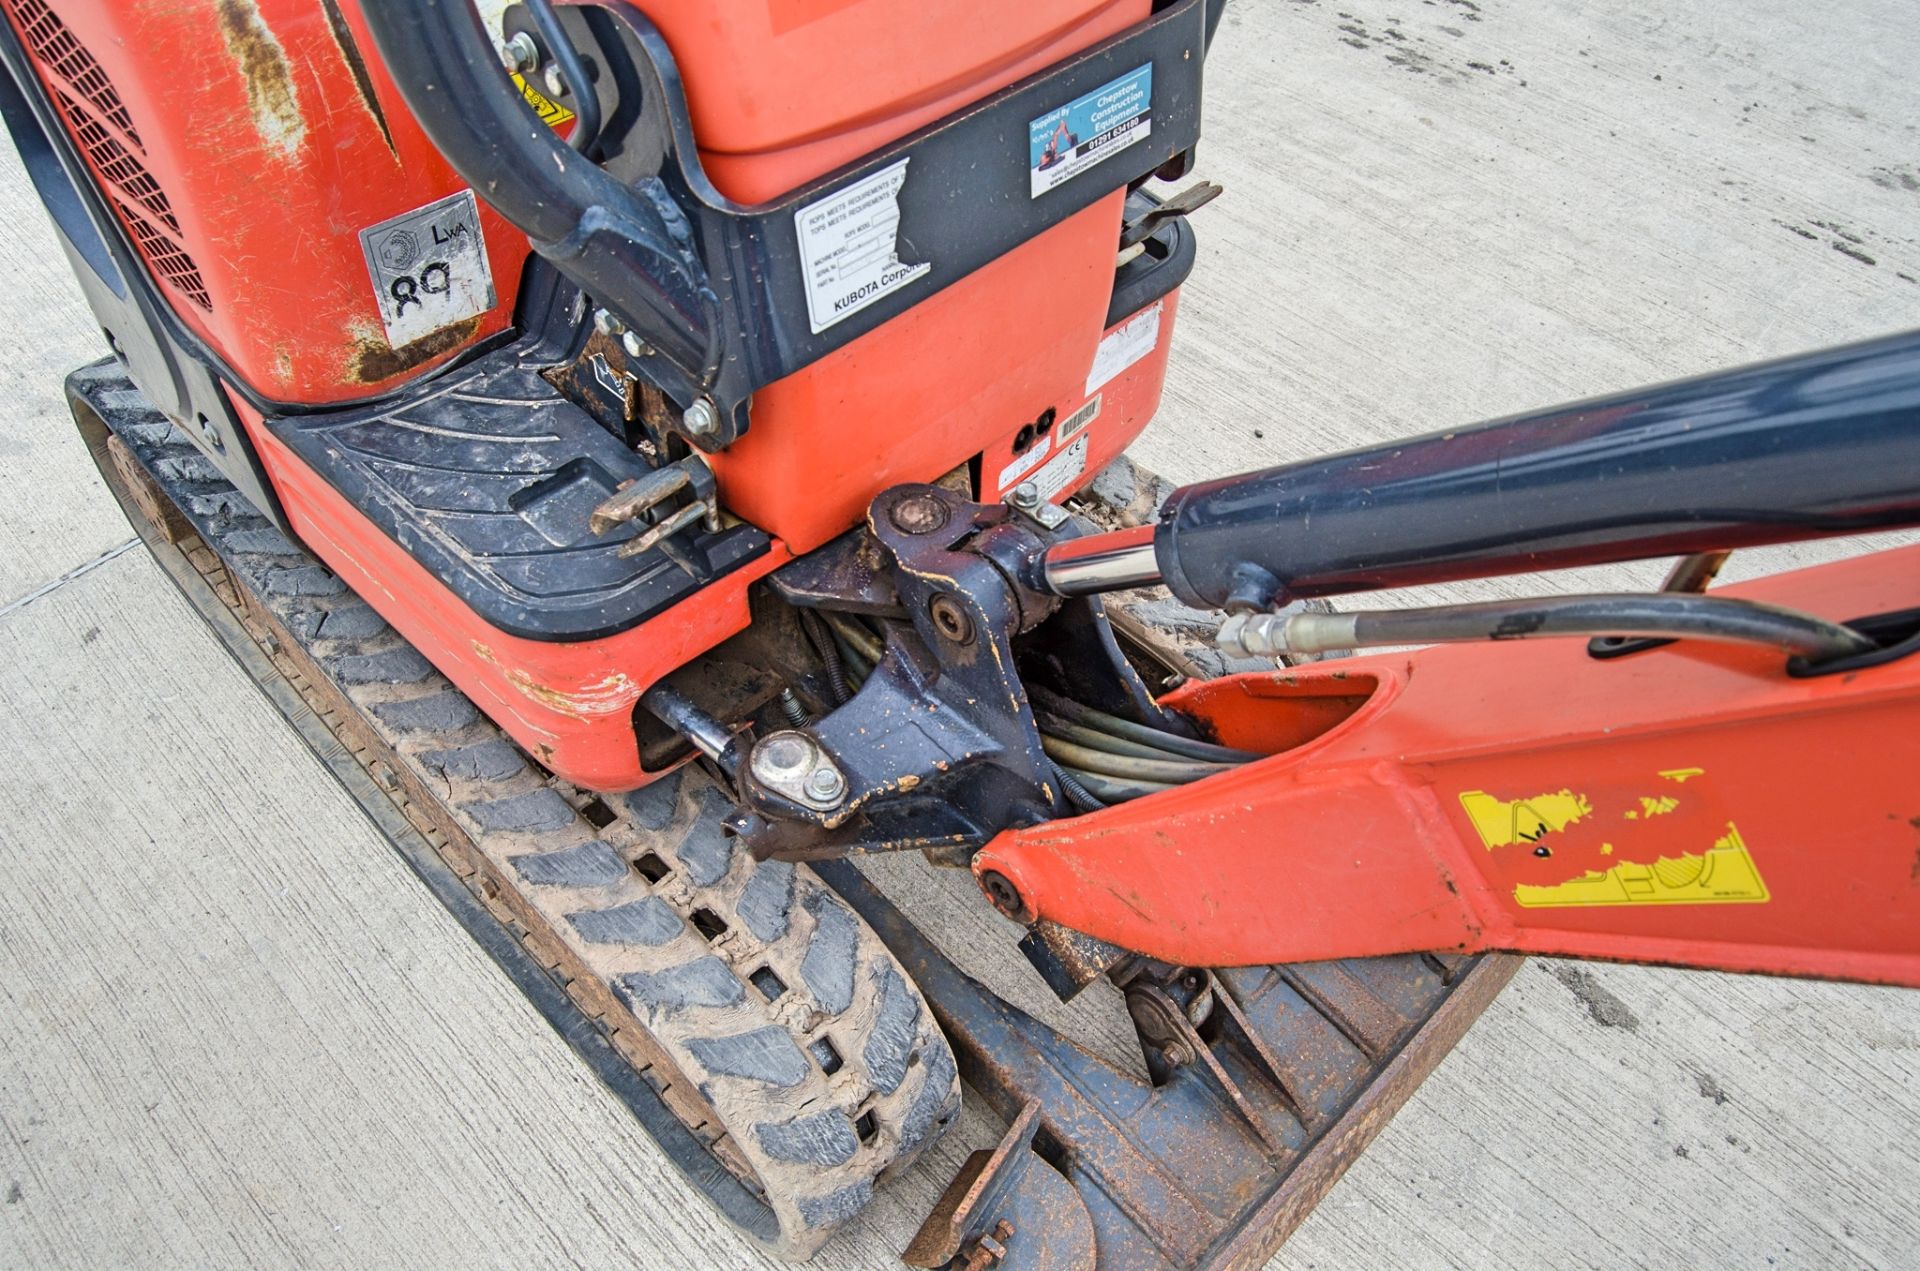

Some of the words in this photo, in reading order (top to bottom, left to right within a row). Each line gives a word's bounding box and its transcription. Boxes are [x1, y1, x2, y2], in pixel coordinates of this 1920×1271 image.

[1091, 90, 1143, 122] Construction
[1097, 82, 1138, 107] Chepstow
[1032, 109, 1060, 131] Supplied
[1095, 103, 1139, 132] Equipment
[1088, 133, 1111, 150] 01291
[827, 203, 847, 219] MEETS
[847, 180, 890, 210] REQUIREMENTS
[828, 213, 847, 229] MEETS
[848, 191, 890, 220] REQUIREMENTS
[834, 281, 879, 312] KUBOTA
